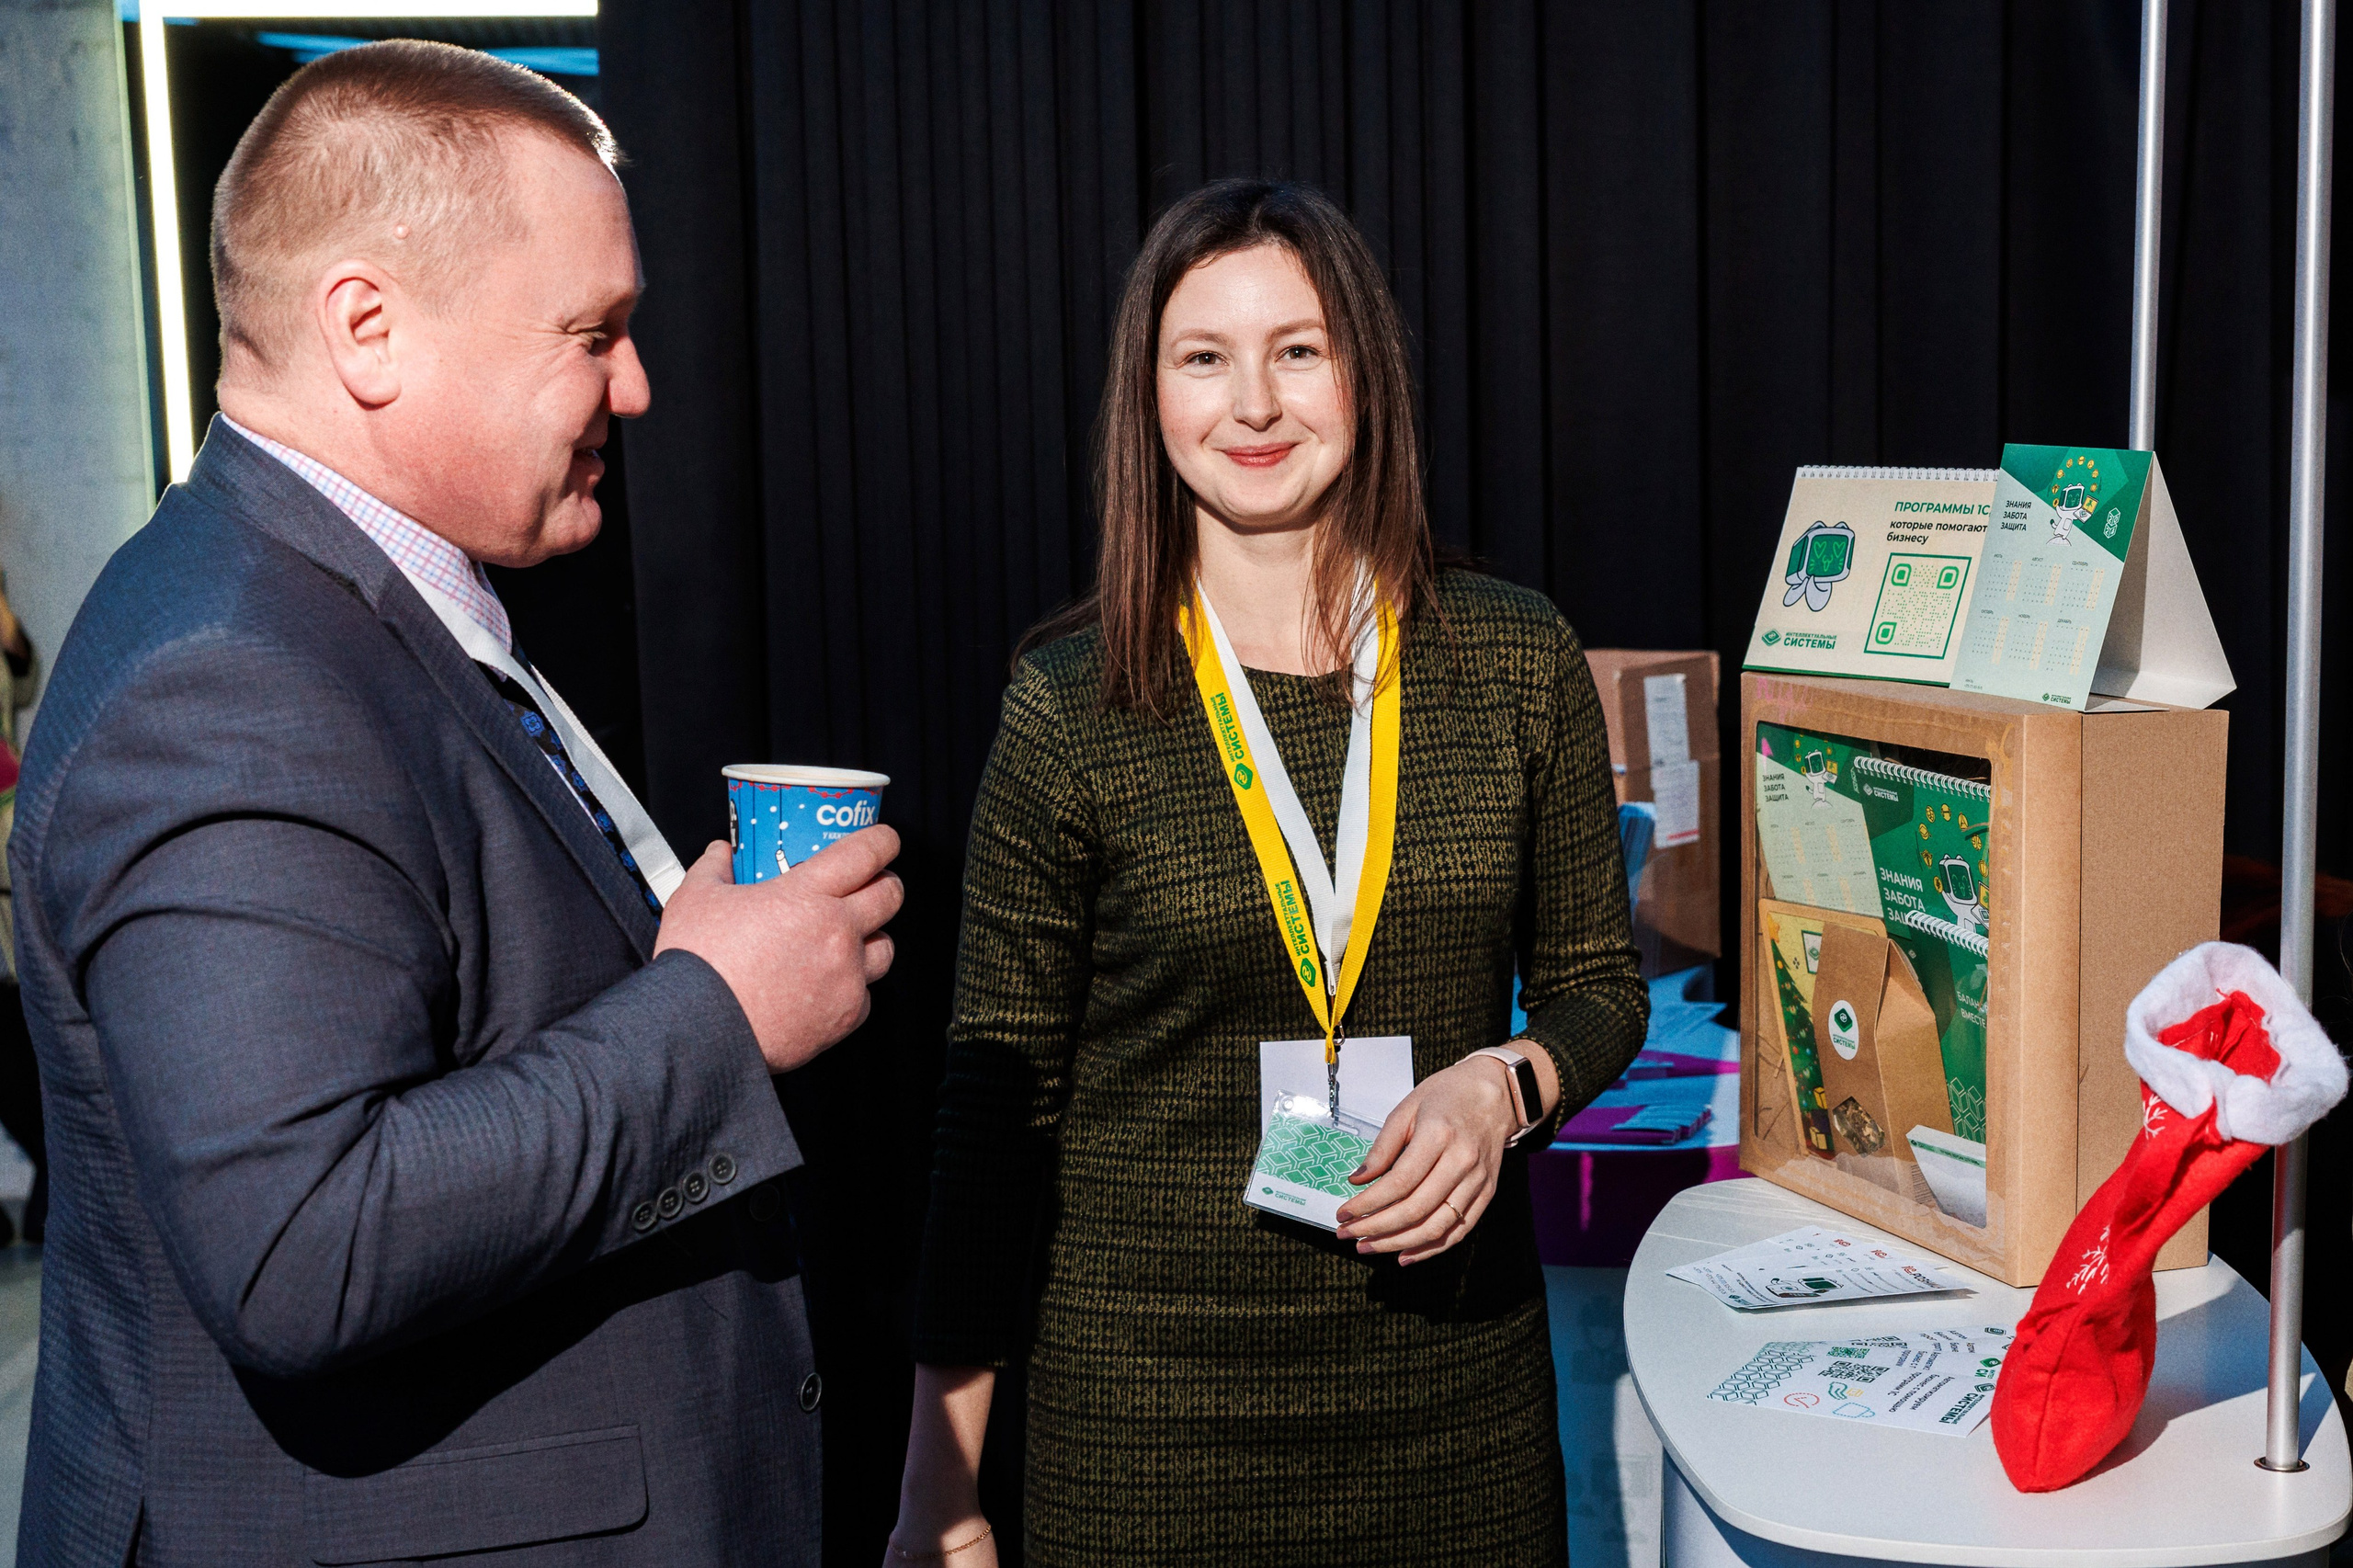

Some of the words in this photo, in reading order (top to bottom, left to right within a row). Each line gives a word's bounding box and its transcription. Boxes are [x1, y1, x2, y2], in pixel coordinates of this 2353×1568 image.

[1894, 501, 1975, 515] ПРОГРАММЫ
[2006, 500, 2032, 509] ЗНАНИЯ
[2003, 511, 2028, 520] ЗАБОТА
[1890, 520, 1933, 531] которые
[1936, 522, 1988, 533] помогают
[2000, 522, 2027, 531] ЗАЩИТА
[1886, 531, 1928, 545] бизнесу
[1784, 637, 1836, 649] СИСТЕМЫ
[1215, 692, 1245, 759] СИСТЕМЫ
[1762, 773, 1785, 782] ЗНАНИЯ
[1764, 784, 1786, 792] ЗАБОТА
[1766, 793, 1789, 802] ЗАЩИТА
[816, 800, 876, 827] cofix
[1880, 867, 1924, 892] ЗНАНИЯ
[1883, 887, 1927, 913] ЗАБОТА
[1280, 880, 1310, 955] СИСТЕМЫ
[1938, 1392, 1978, 1425] СИСТЕМЫ
